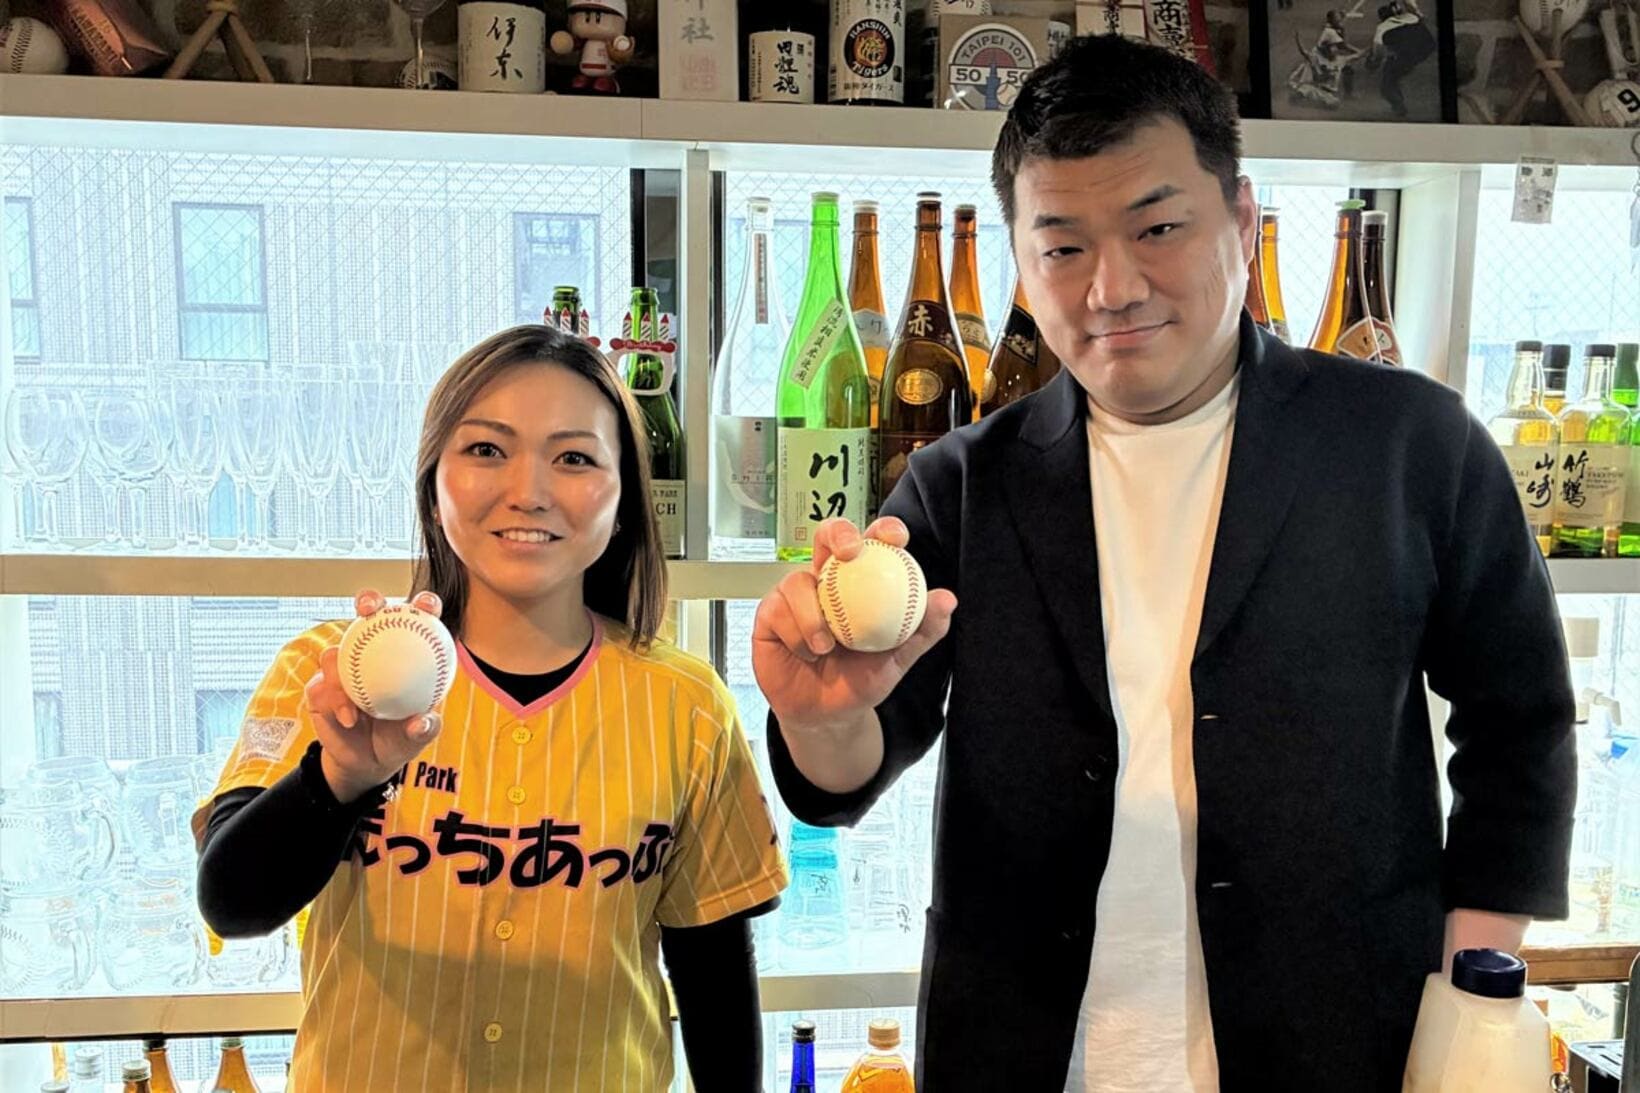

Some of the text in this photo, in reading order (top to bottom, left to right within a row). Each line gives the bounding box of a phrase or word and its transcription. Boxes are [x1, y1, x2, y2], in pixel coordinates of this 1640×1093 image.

[961, 35, 1026, 61] TAIPEI 101
[956, 68, 981, 82] 50
[908, 304, 933, 337] 赤
[1526, 452, 1555, 509] 山崎
[1560, 450, 1590, 509] 竹鶴
[414, 761, 458, 793] Park
